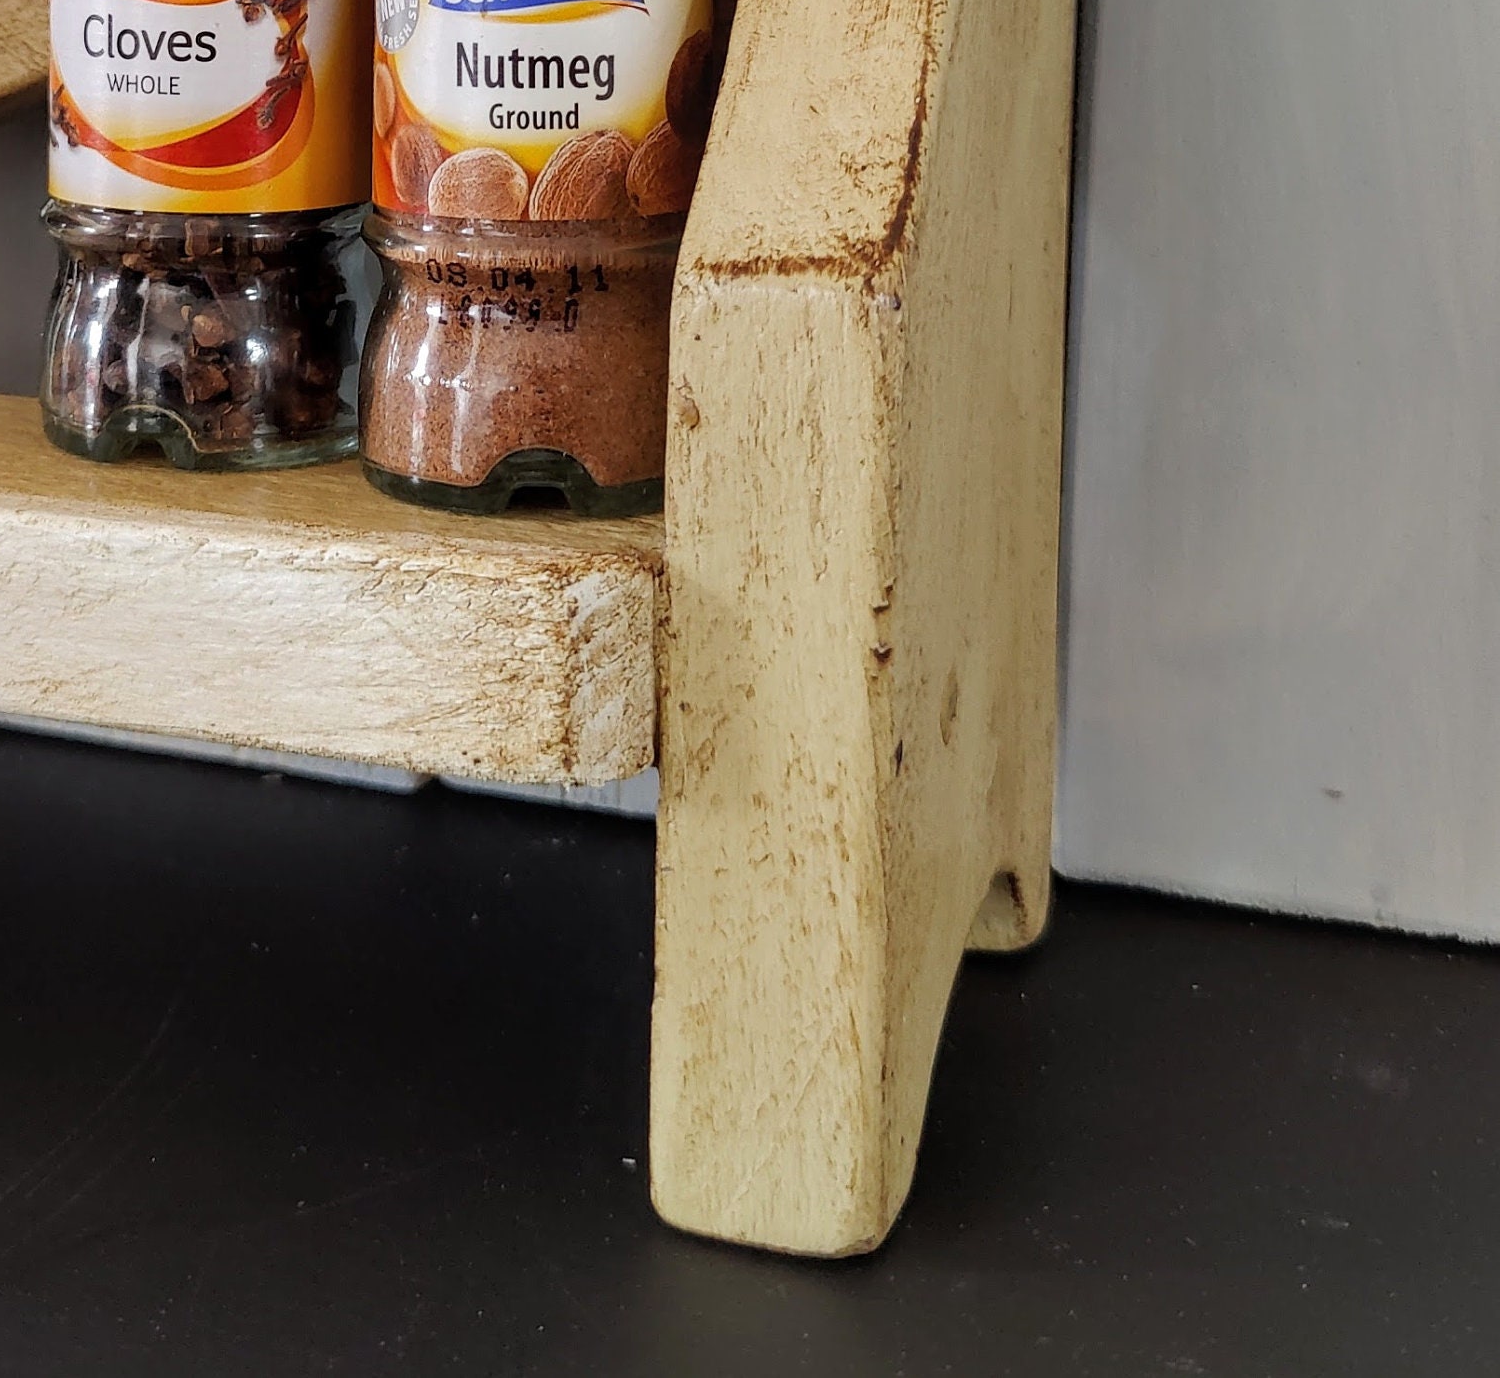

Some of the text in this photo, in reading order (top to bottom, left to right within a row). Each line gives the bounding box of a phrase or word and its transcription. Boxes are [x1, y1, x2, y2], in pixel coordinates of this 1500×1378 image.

[83, 14, 217, 62] Cloves
[383, 23, 413, 49] FRESH
[107, 73, 181, 96] WHOLE
[456, 42, 615, 100] Nutmeg
[489, 103, 579, 130] Ground
